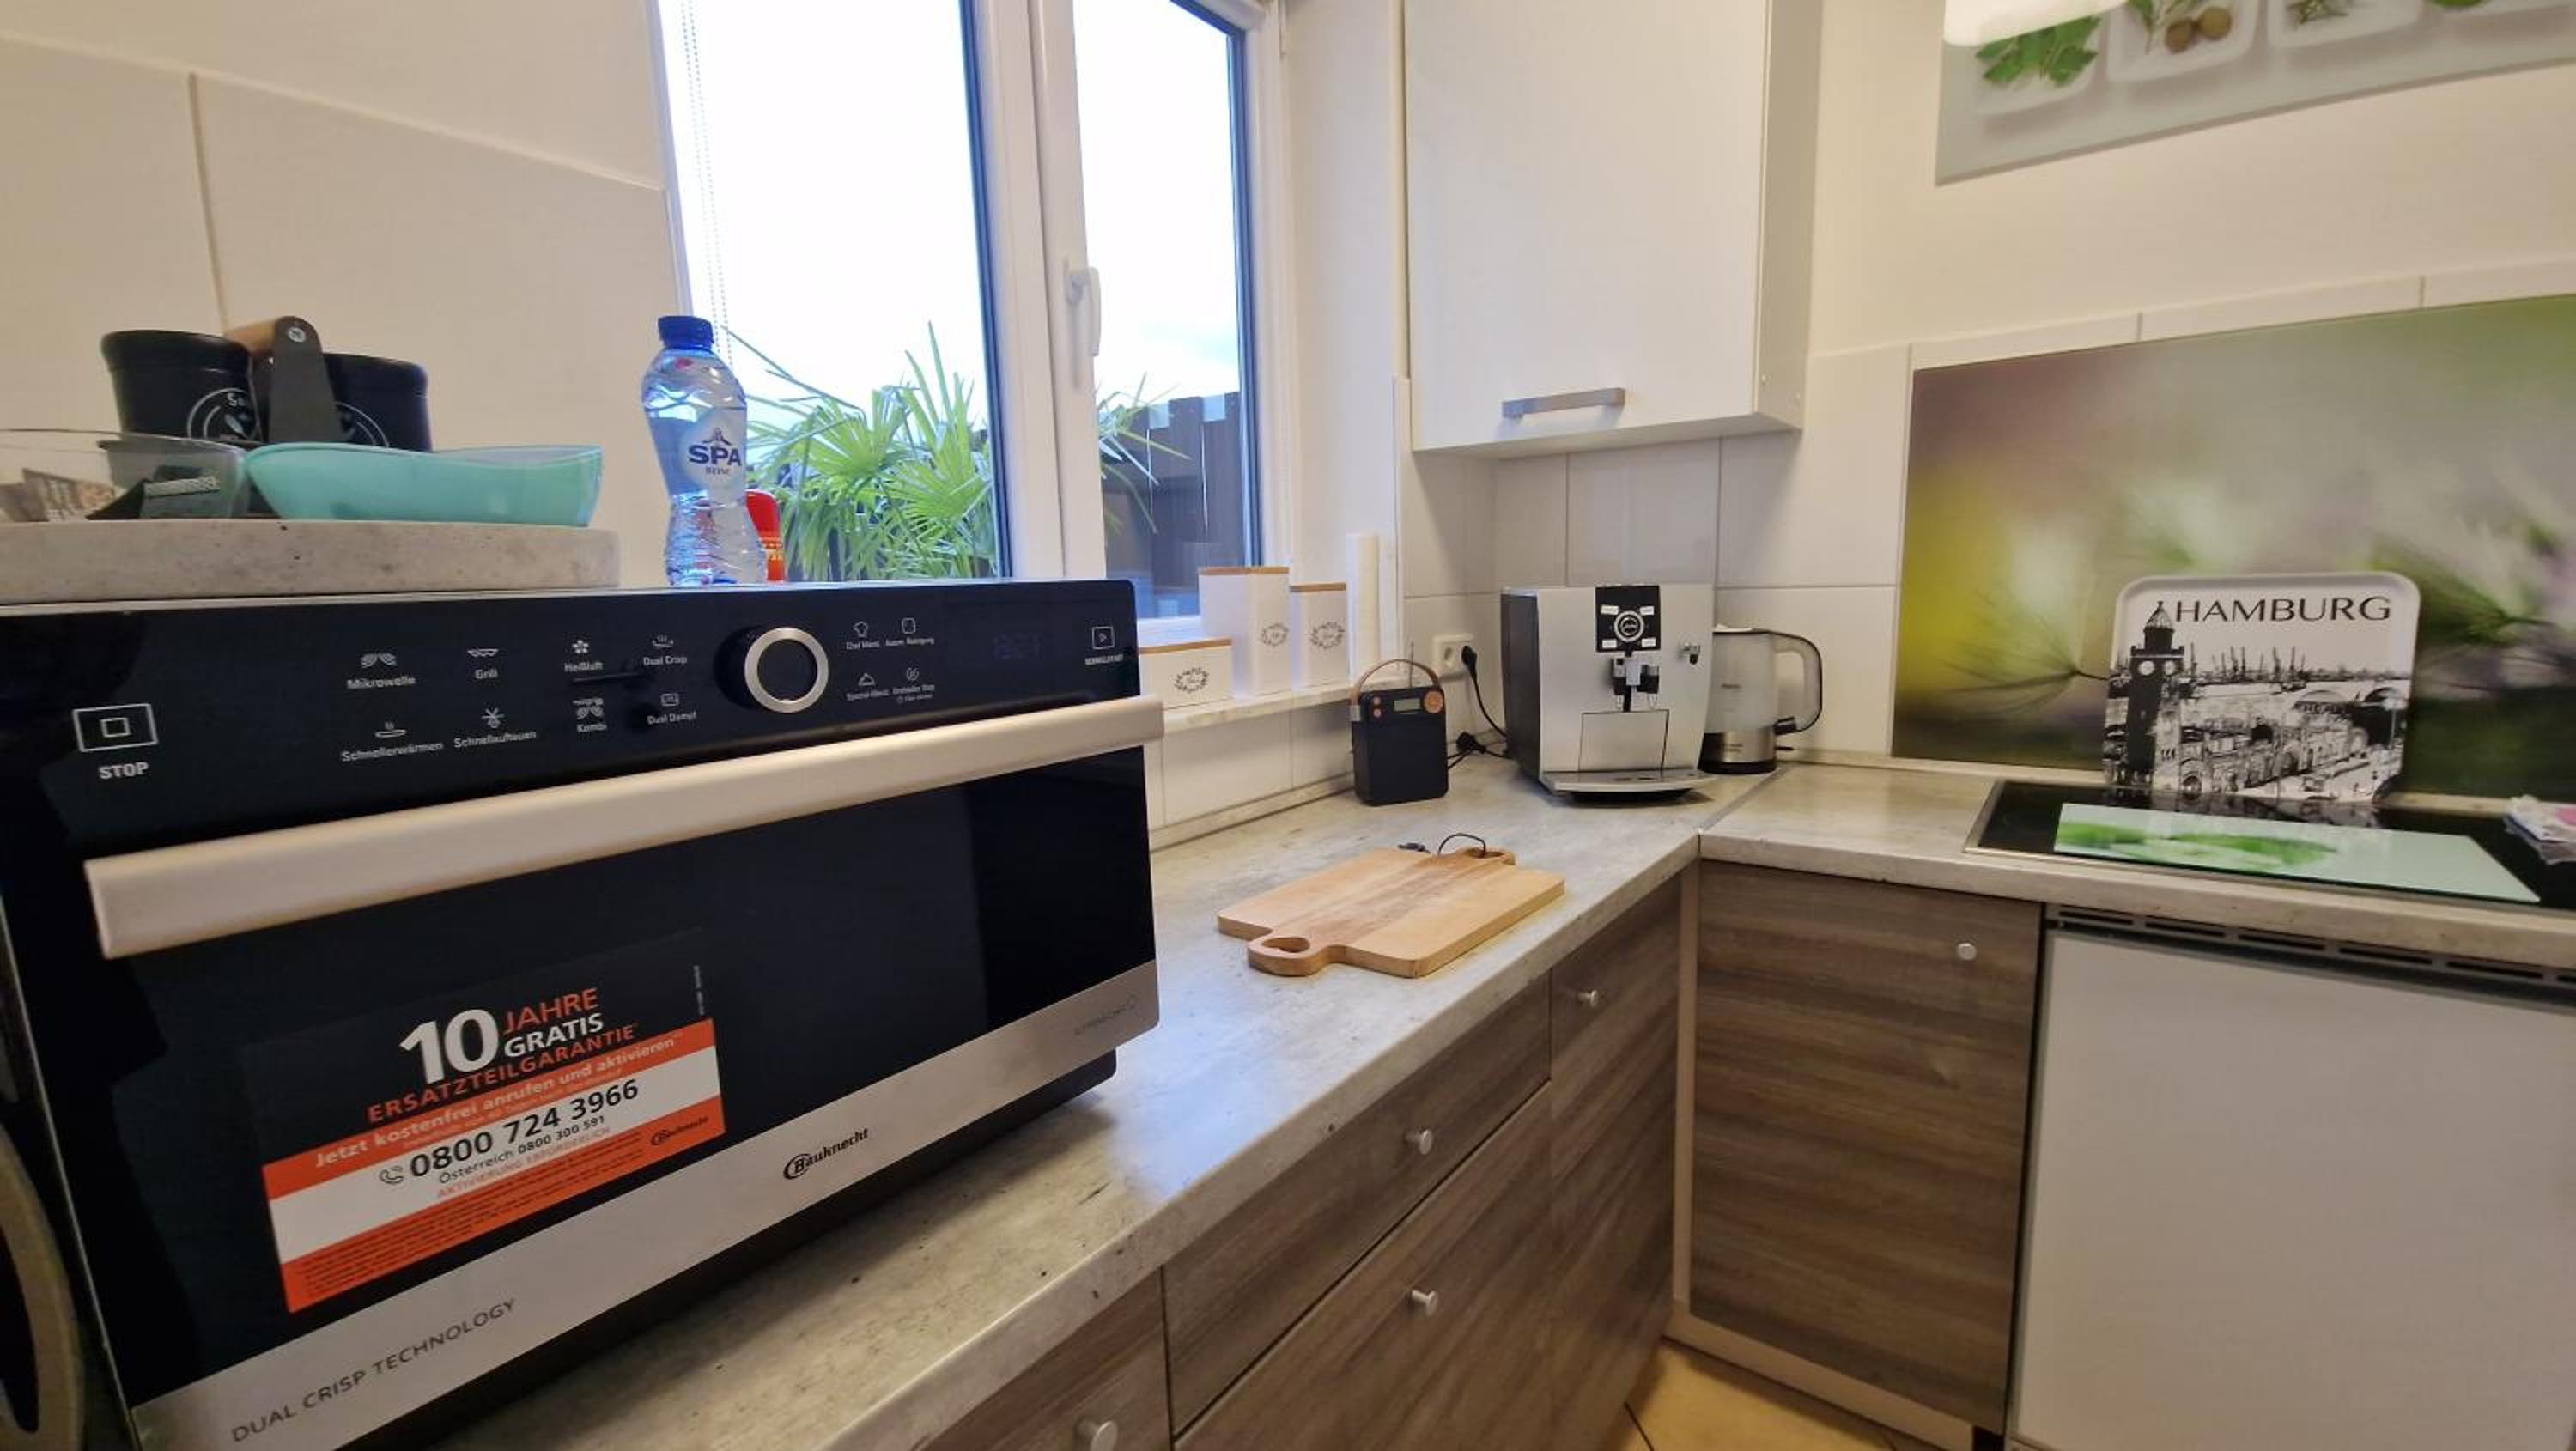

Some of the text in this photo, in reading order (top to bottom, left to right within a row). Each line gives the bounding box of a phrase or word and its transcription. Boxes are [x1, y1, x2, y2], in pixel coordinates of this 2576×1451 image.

[689, 445, 742, 466] SPA
[2175, 595, 2391, 622] HAMBURG
[475, 668, 499, 680] Grill
[643, 656, 663, 666] Dual
[346, 675, 416, 689] Mikrowelle
[647, 713, 669, 726] Dual
[98, 761, 149, 780] STOP
[501, 987, 600, 1035] JAHRE
[399, 1009, 500, 1084] 10
[503, 1012, 605, 1058] GRATIS
[316, 1139, 368, 1168] Jetzt
[374, 1098, 478, 1146] kostenfrei
[483, 1078, 556, 1111] anrufen
[559, 1065, 592, 1085] und
[410, 1131, 494, 1178] 0800
[502, 1107, 562, 1144] 724
[569, 1078, 639, 1120] 3966
[517, 1134, 552, 1155] 0800
[555, 1123, 580, 1142] 300
[582, 1115, 605, 1131] 591
[783, 1127, 869, 1181] Bauknecht
[231, 1297, 517, 1443] DUAL CRISP TECHNOLOGY
